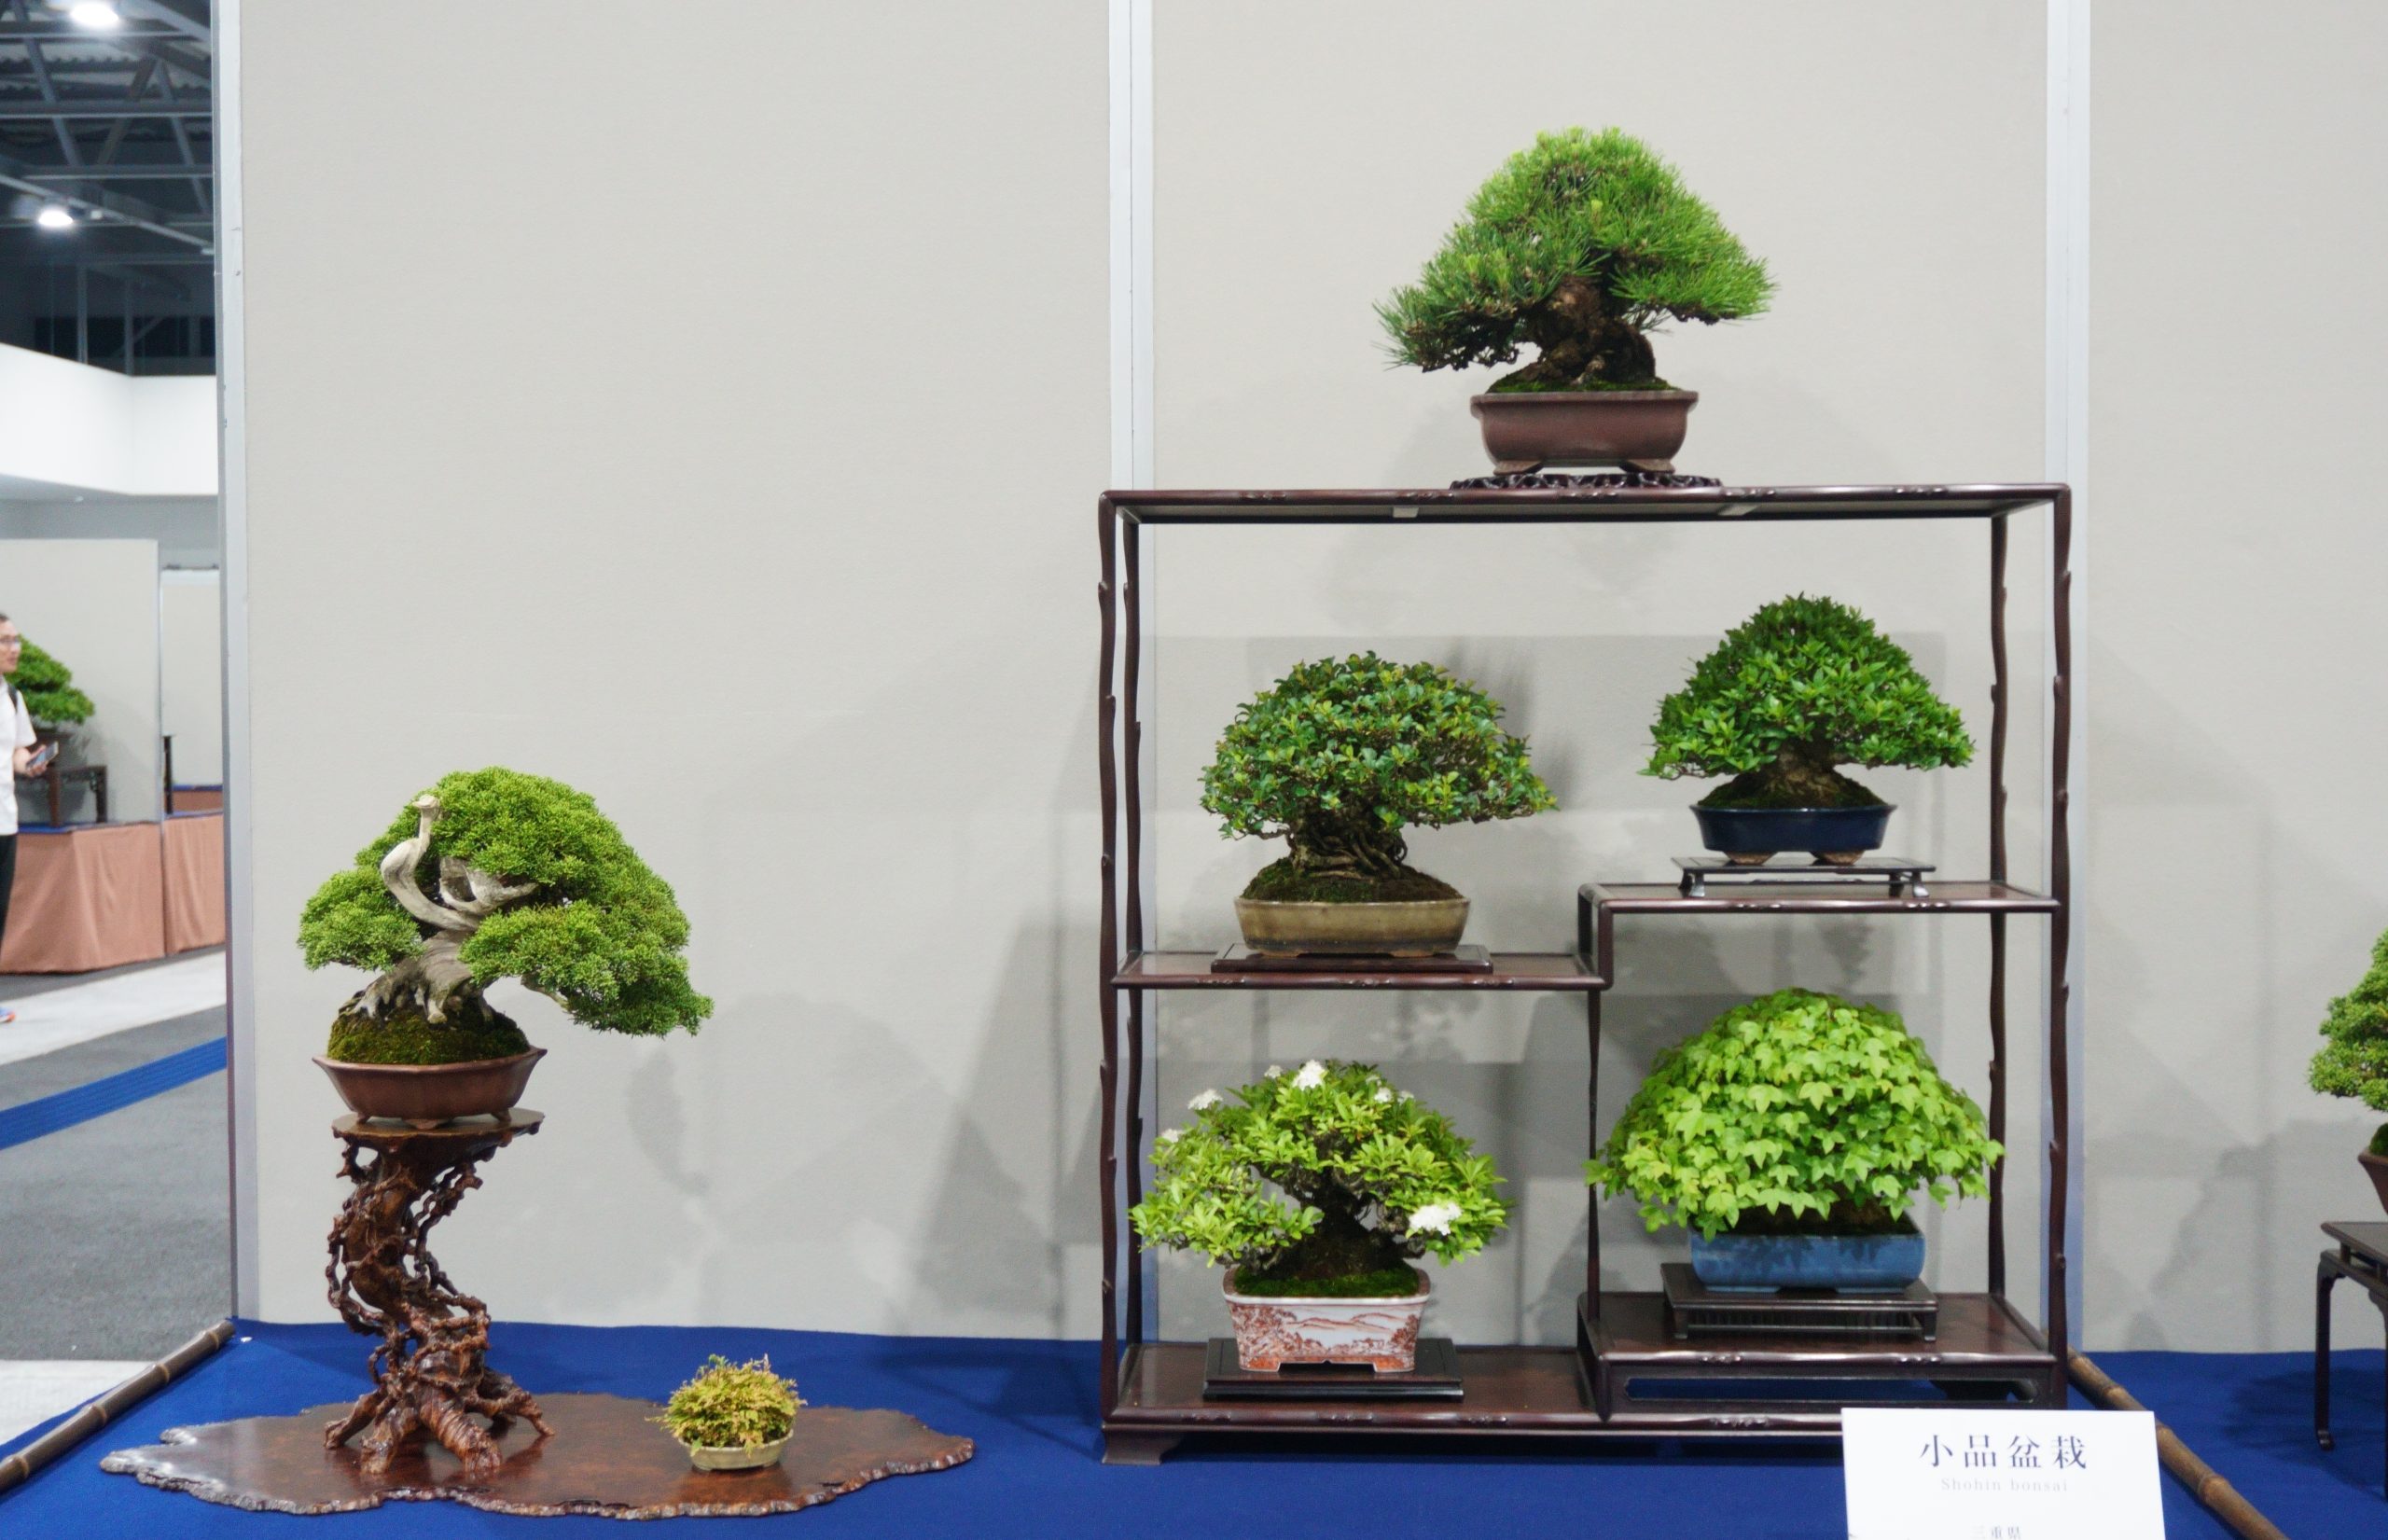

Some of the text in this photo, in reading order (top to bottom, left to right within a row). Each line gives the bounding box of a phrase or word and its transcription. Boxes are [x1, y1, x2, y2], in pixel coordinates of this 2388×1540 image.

[1920, 1433, 2088, 1470] 小品盆栽
[1940, 1478, 2068, 1492] Shohin bonsai
